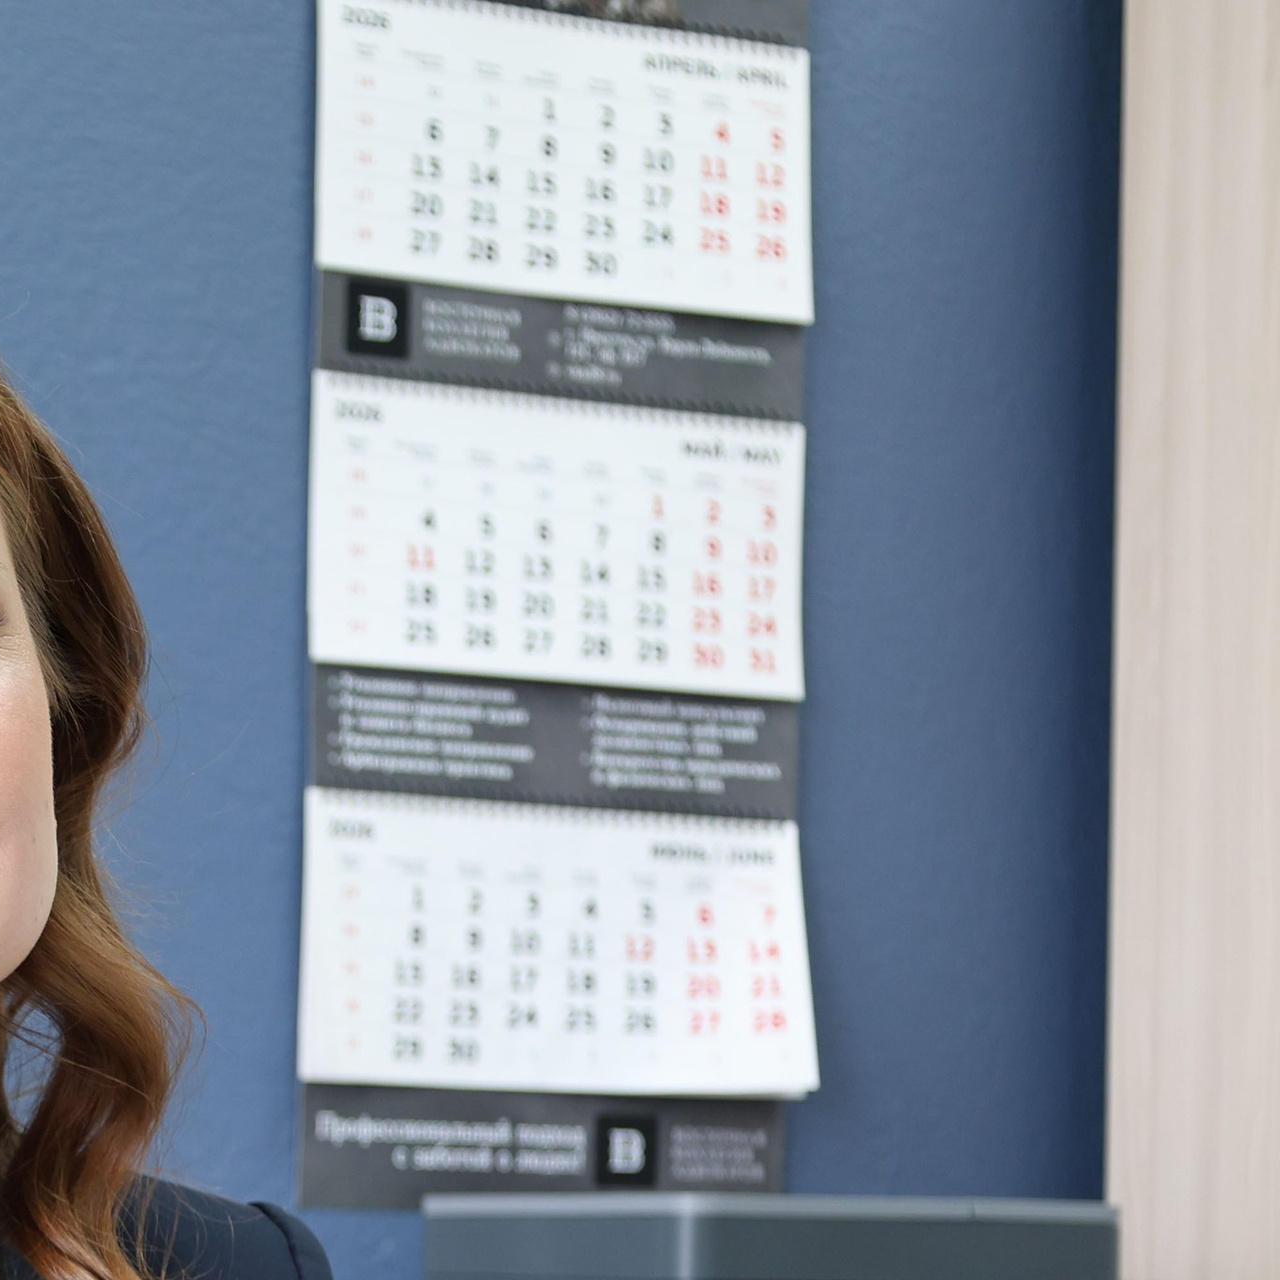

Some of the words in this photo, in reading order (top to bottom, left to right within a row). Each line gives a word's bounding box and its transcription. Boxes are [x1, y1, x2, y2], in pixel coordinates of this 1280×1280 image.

[543, 98, 557, 124] 1
[600, 104, 615, 131] 2
[659, 112, 673, 136] 3
[715, 124, 729, 142] 4
[771, 129, 784, 151] 5
[427, 119, 442, 142] 6
[486, 125, 500, 150] 7
[542, 136, 557, 157] 8
[600, 143, 616, 165] 9
[644, 148, 675, 174] 10
[702, 156, 728, 181] 11
[757, 164, 784, 188] 12
[412, 155, 442, 180] 13
[471, 164, 500, 186] 14
[527, 170, 557, 196] 15
[587, 179, 615, 202] 16
[644, 184, 672, 211] 17
[702, 195, 729, 215] 18
[758, 200, 785, 223] 19
[410, 191, 443, 217] 20
[468, 199, 497, 227] 21
[526, 207, 556, 234] 22
[585, 214, 615, 239] 23
[643, 221, 674, 245] 24
[700, 229, 729, 252] 25
[757, 236, 785, 259] 26
[410, 228, 441, 254] 27
[469, 238, 498, 261] 28
[527, 245, 557, 268] 29
[586, 251, 617, 275] 30
[653, 495, 664, 519] 1
[707, 500, 720, 524] 2
[764, 505, 776, 527] 3
[421, 511, 436, 530] 4
[480, 513, 496, 538] 5
[537, 520, 552, 542] 6
[596, 523, 610, 549] 7
[652, 532, 666, 553] 8
[707, 538, 721, 558] 9
[748, 542, 776, 565] 10
[408, 546, 434, 570] 11
[465, 550, 495, 577] 12
[524, 556, 553, 580] 13
[582, 562, 610, 584] 14
[638, 566, 666, 592] 15
[694, 575, 721, 594] 16
[749, 577, 775, 601] 17
[408, 584, 436, 606] 18
[466, 589, 496, 612] 19
[522, 592, 554, 618] 20
[581, 597, 609, 625] 21
[636, 602, 666, 629] 22
[693, 609, 721, 632] 23
[748, 615, 776, 636] 24
[406, 619, 436, 643] 25
[466, 625, 494, 647] 26
[524, 628, 553, 652] 27
[582, 636, 610, 657] 28
[639, 639, 667, 662] 29
[694, 644, 722, 666] 30
[750, 649, 772, 669] 31
[411, 885, 425, 913] 1
[468, 887, 483, 916] 2
[527, 892, 540, 918] 3
[584, 898, 598, 918] 4
[640, 899, 656, 924] 5
[698, 906, 713, 925] 6
[764, 906, 775, 924] 7
[410, 925, 425, 946] 8
[468, 928, 482, 951] 9
[511, 929, 541, 955] 10
[568, 932, 596, 960] 11
[626, 936, 654, 961] 12
[689, 940, 717, 962] 13
[750, 944, 779, 961] 14
[395, 960, 424, 987] 15
[453, 966, 480, 988] 16
[510, 965, 539, 993] 17
[569, 972, 596, 992] 18
[627, 974, 656, 997] 19
[688, 976, 720, 999] 20
[752, 976, 780, 999] 21
[392, 997, 422, 1025] 22
[450, 1001, 479, 1026] 23
[508, 1006, 538, 1028] 24
[565, 1006, 597, 1033] 25
[625, 1010, 657, 1034] 26
[690, 1011, 720, 1035] 27
[754, 1011, 786, 1032] 28
[393, 1036, 422, 1059] 29
[449, 1038, 479, 1061] 30
